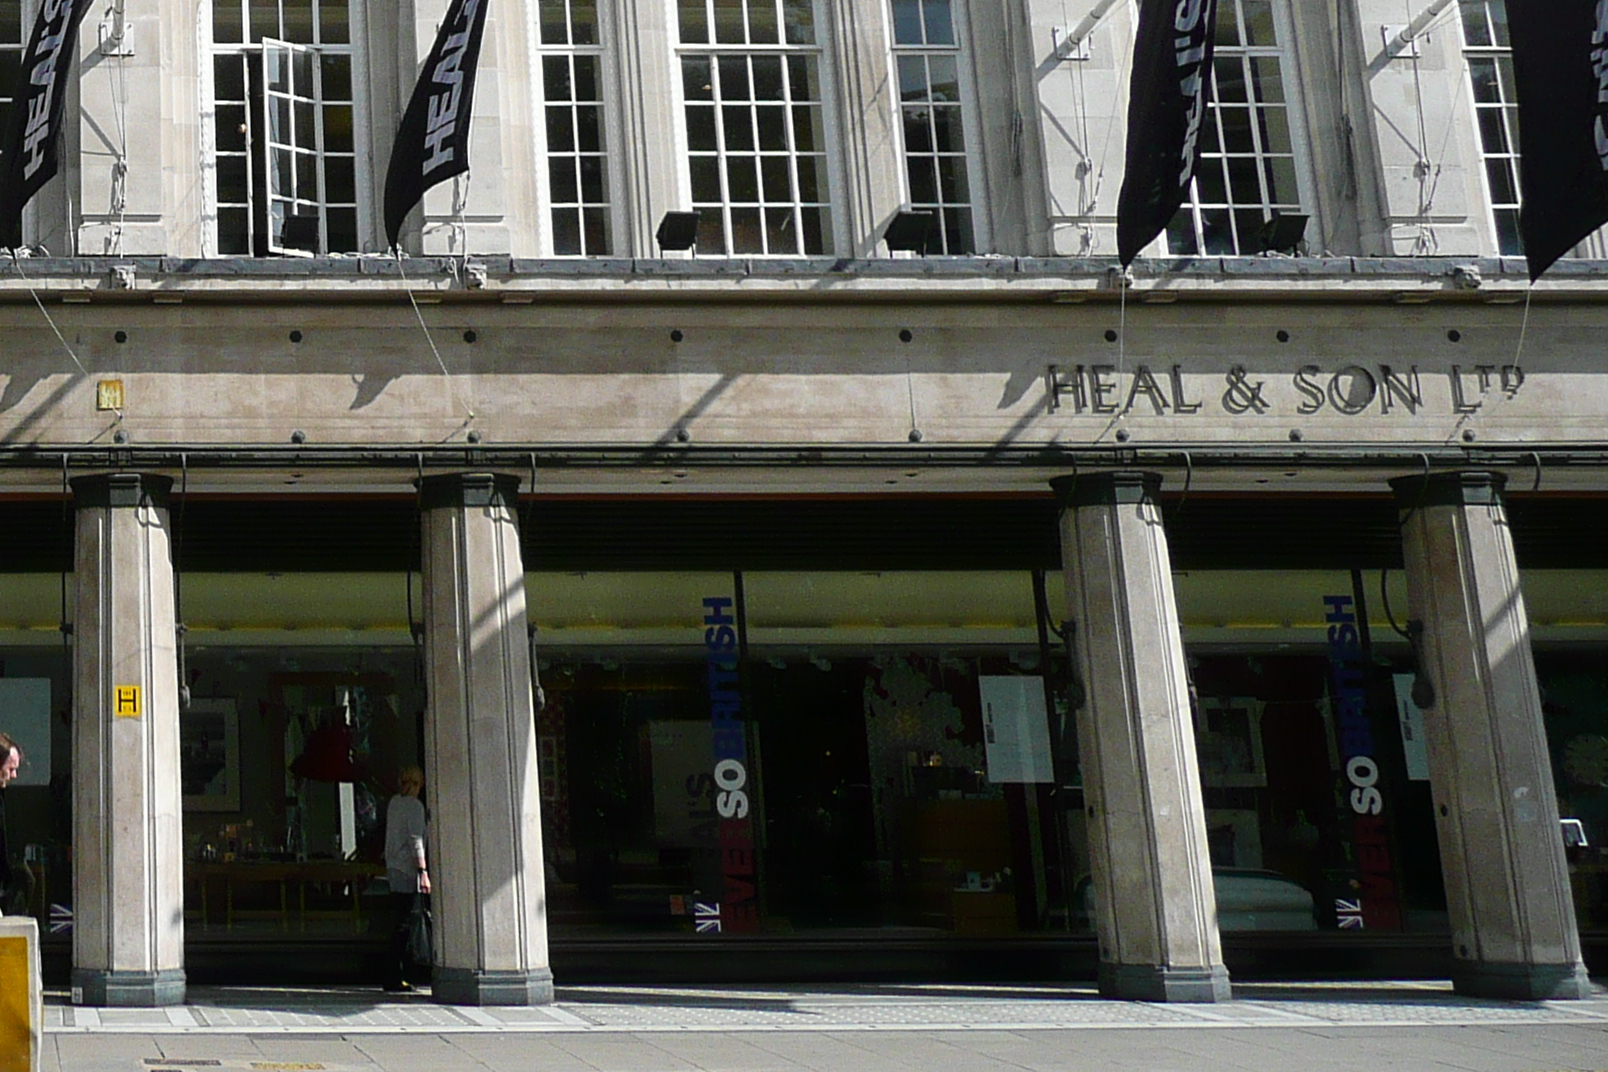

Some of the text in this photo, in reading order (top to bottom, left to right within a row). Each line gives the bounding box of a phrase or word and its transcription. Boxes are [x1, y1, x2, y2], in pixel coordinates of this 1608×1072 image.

[1046, 364, 1203, 414] HEAL
[1222, 364, 1270, 415] &
[1292, 364, 1423, 415] SON
[117, 688, 137, 713] H
[713, 757, 750, 819] SO
[1345, 754, 1384, 817] SO
